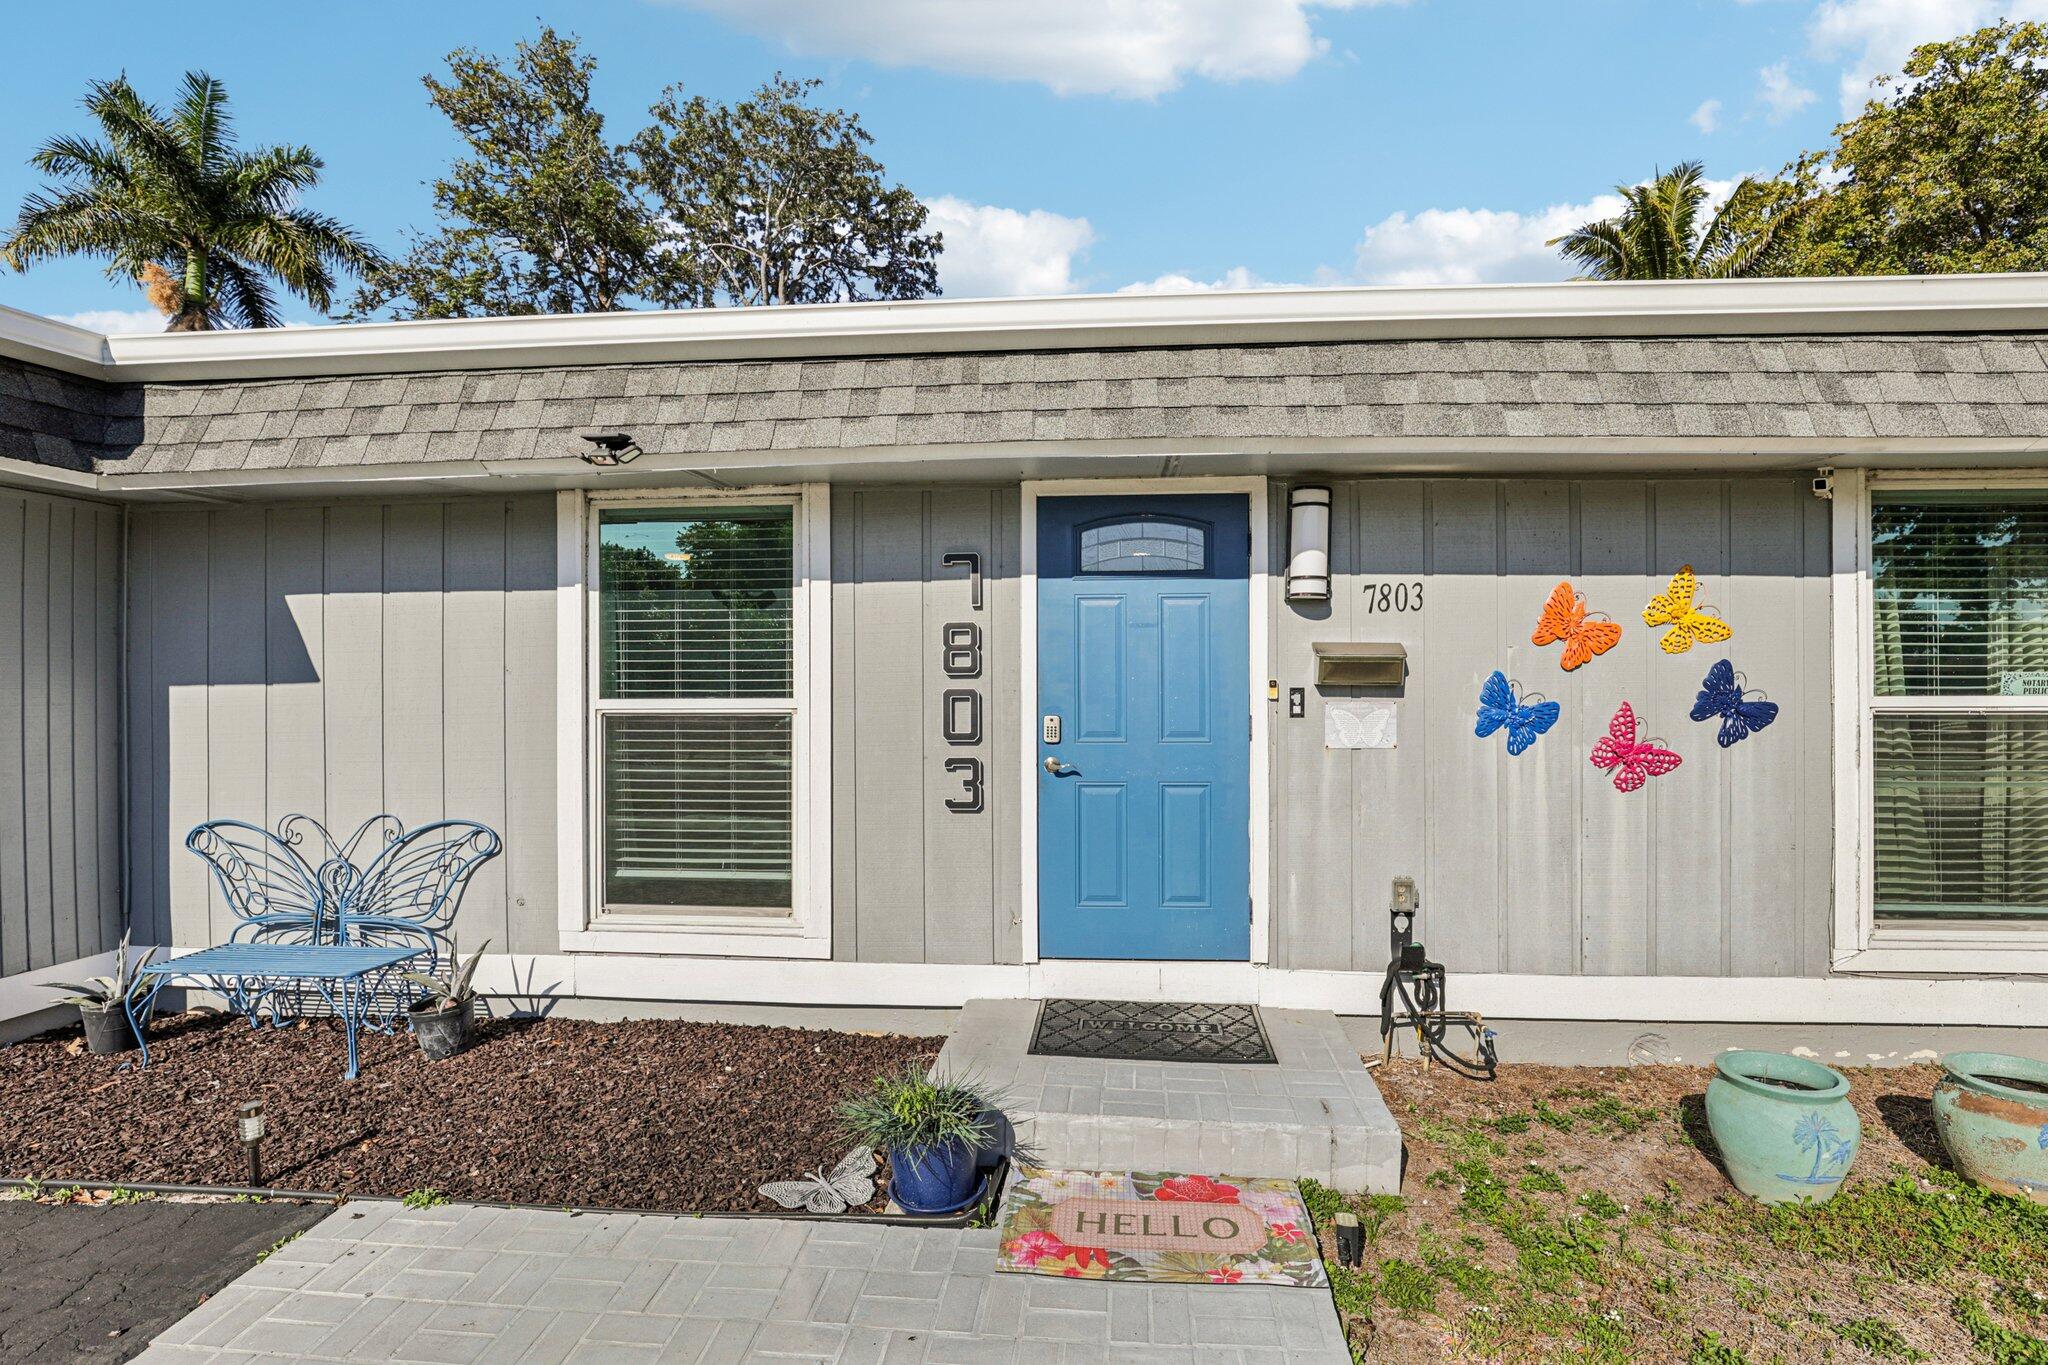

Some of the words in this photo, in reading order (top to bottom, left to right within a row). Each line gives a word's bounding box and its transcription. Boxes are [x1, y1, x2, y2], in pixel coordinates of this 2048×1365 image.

[1363, 582, 1424, 614] 7803
[943, 553, 982, 812] 7803
[2022, 679, 2048, 687] NOTAR
[1089, 1020, 1212, 1033] WELCOME
[1075, 1210, 1240, 1240] HELLO
